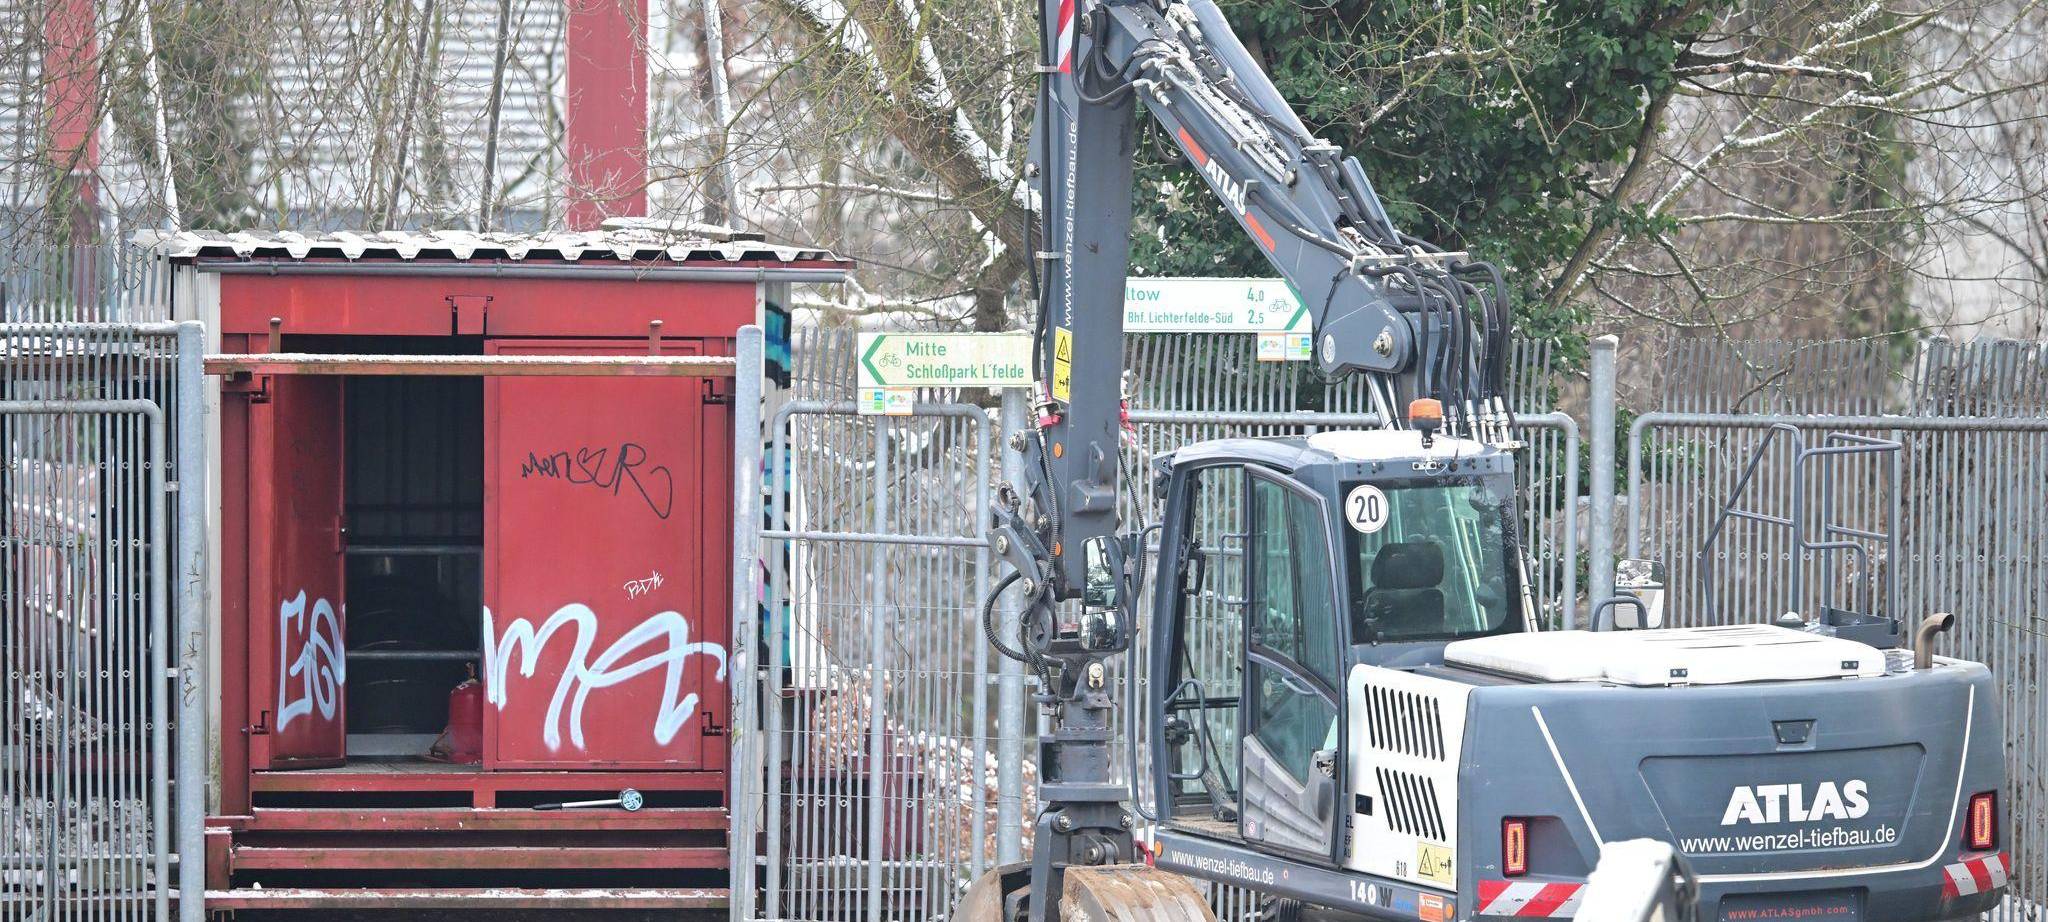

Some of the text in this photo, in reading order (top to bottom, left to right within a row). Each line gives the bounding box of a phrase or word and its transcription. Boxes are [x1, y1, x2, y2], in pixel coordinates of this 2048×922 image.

[1065, 121, 1078, 327] www.wenzel-tiefbau.de
[1247, 287, 1264, 302] 4.0
[1128, 309, 1264, 325] Bhf. Lichterfelde-Süd 2.5
[906, 342, 947, 356] Mitte
[906, 364, 977, 381] Schloßpark
[1355, 495, 1379, 523] 20
[1720, 779, 1870, 826] ATLAS
[1681, 824, 1896, 853] www.wenzel-tiefbau.de
[1171, 850, 1274, 885] www.wenzel-tiefbau.de
[1350, 879, 1377, 905] 140
[1380, 886, 1393, 908] W
